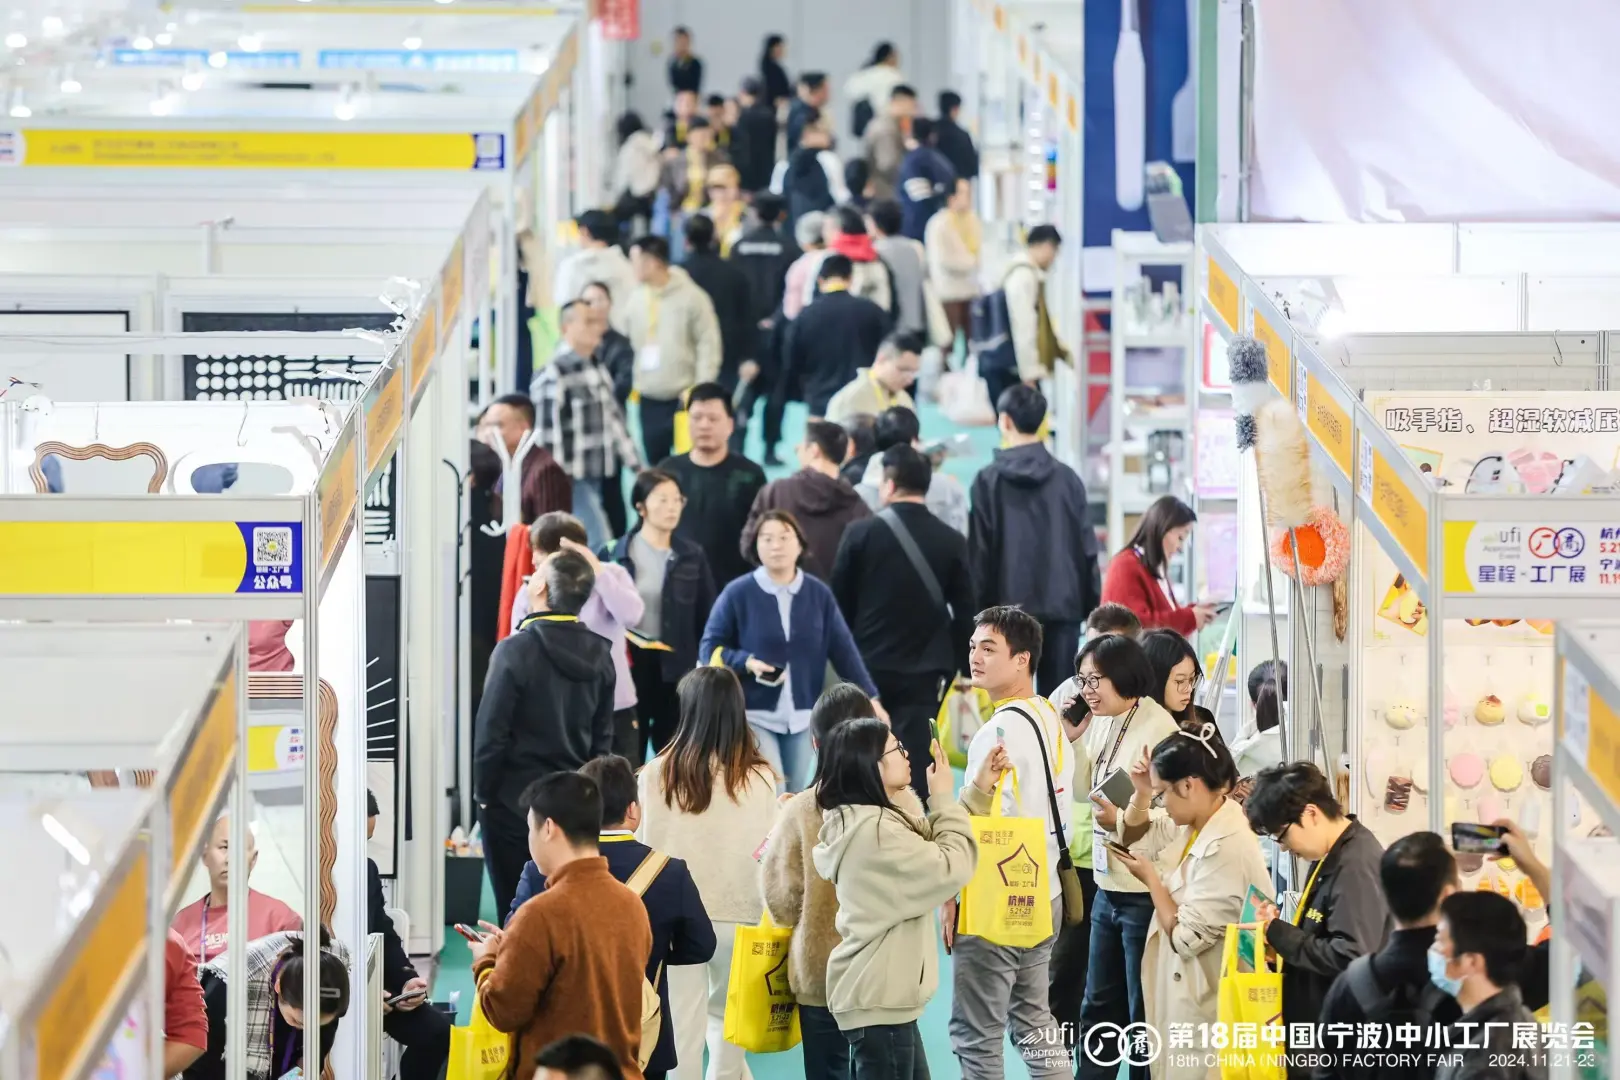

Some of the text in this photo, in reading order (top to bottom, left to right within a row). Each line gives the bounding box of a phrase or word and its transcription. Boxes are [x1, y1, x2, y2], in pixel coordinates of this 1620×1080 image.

[1385, 407, 1620, 434] 吸手指、超湿软减压
[1499, 526, 1521, 543] ufi
[254, 575, 293, 590] 公众号
[1008, 895, 1034, 906] 杭州展
